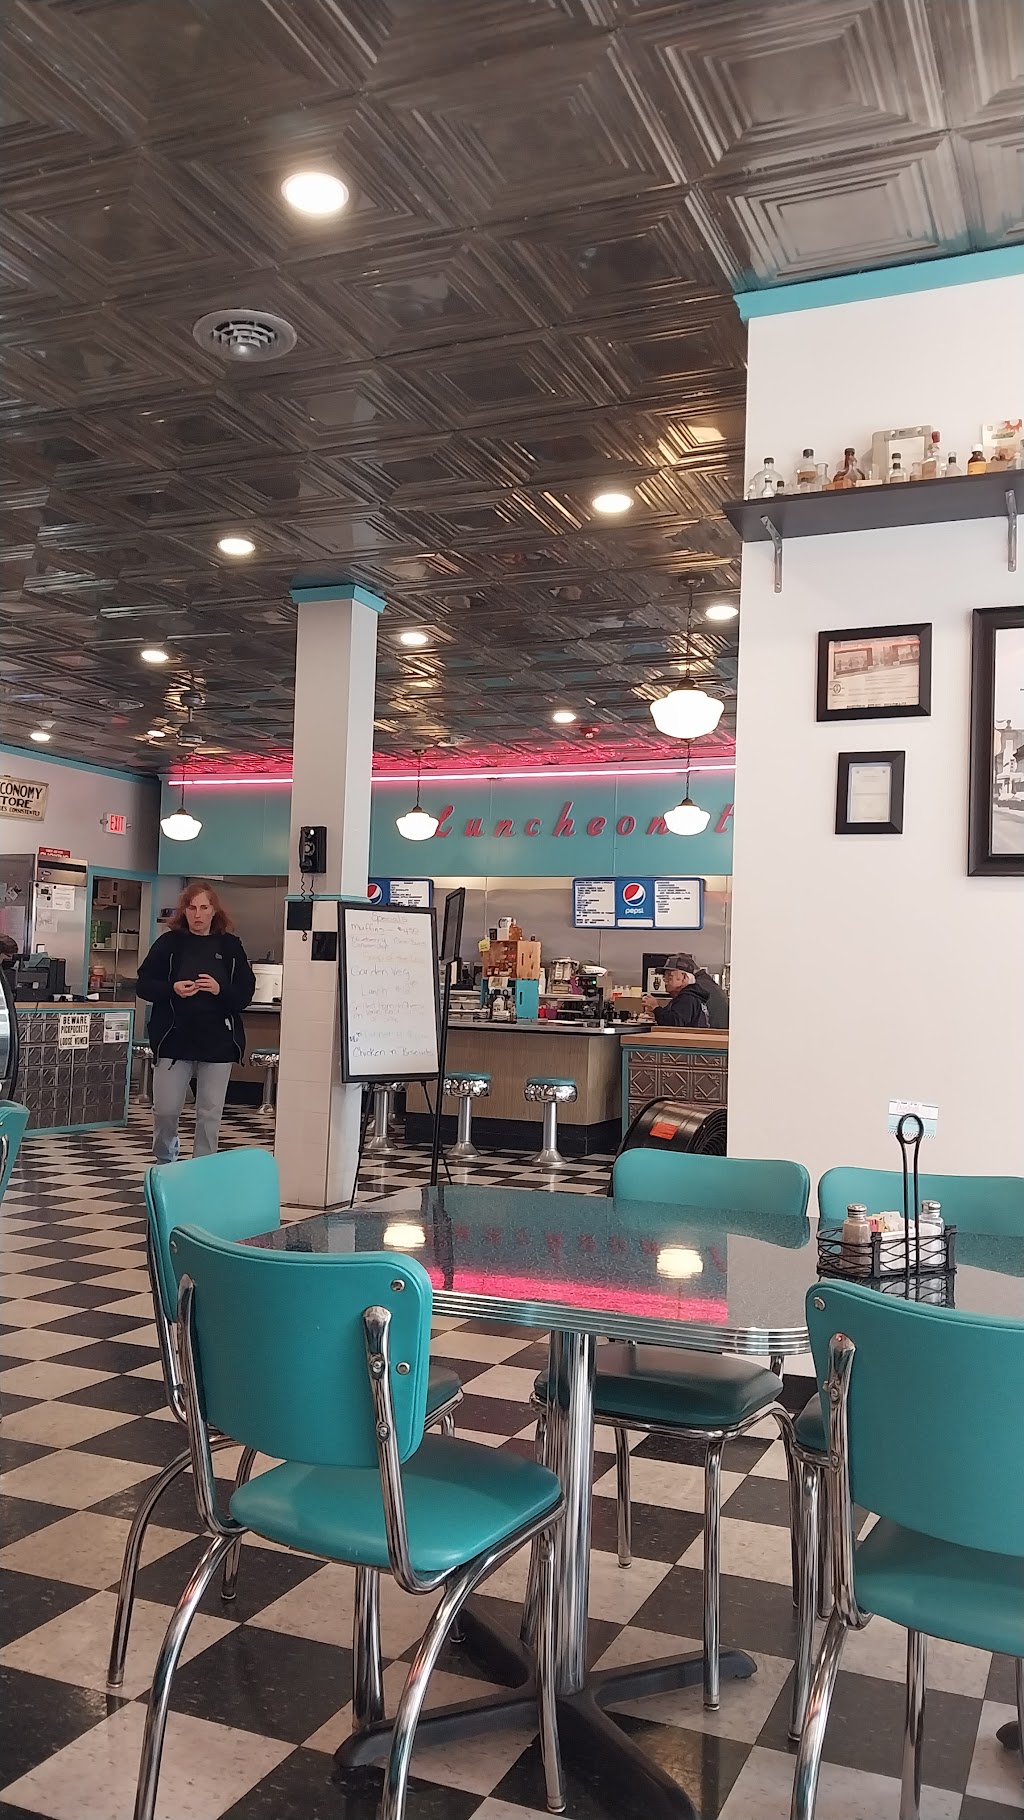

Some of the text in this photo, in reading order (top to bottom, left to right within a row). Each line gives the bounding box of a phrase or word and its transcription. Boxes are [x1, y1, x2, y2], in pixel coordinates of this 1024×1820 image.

[0, 782, 42, 799] CONOMY
[0, 796, 33, 809] TORE
[110, 815, 124, 831] EXIT
[433, 801, 734, 837] Luncheont
[624, 907, 645, 915] pepsi
[350, 964, 388, 976] Garden
[63, 1016, 88, 1024] BEWARE
[61, 1025, 88, 1034] PICKPOCKETS
[60, 1037, 73, 1045] LOOSE
[353, 1047, 386, 1057] Chicken
